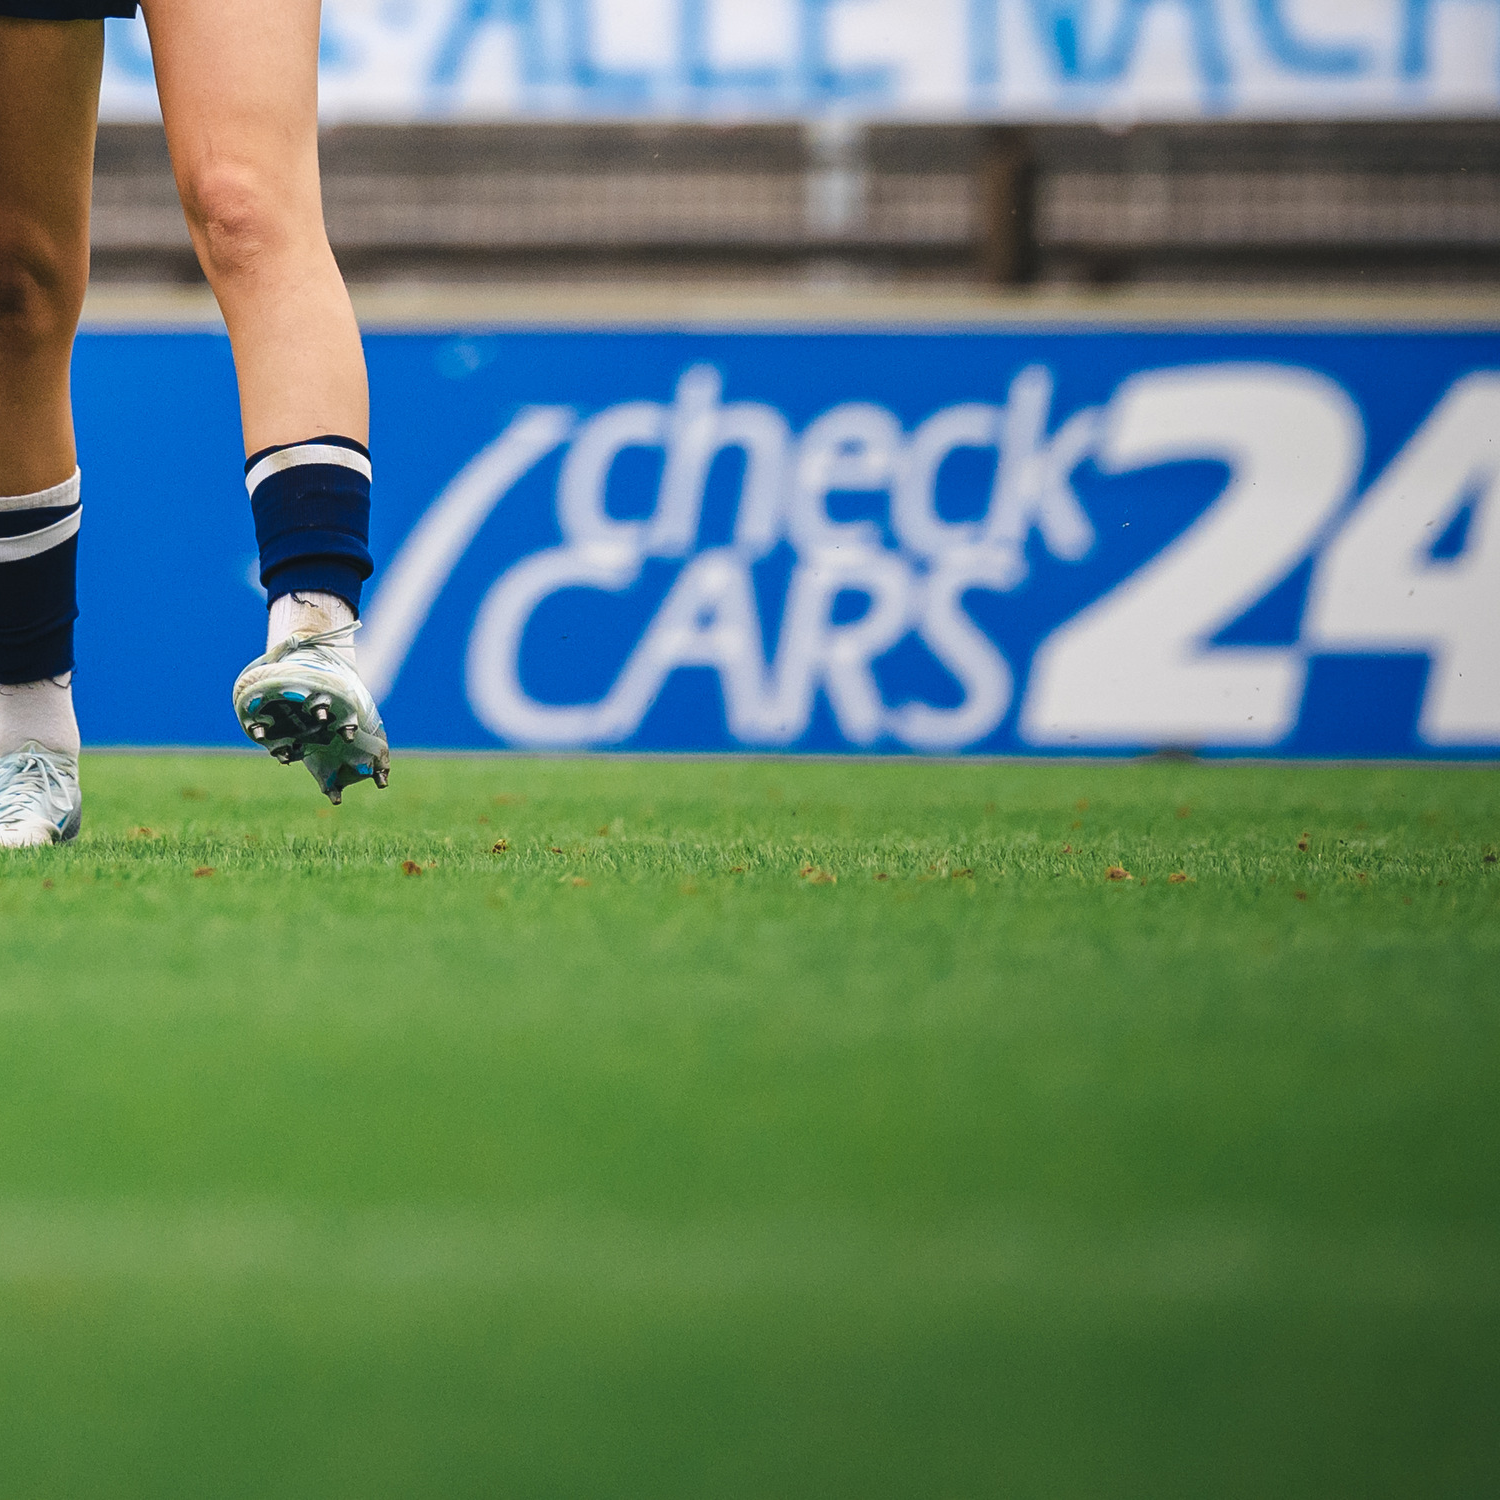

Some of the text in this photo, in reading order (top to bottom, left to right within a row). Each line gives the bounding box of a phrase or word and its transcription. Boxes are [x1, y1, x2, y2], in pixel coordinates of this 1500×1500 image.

[555, 362, 1105, 568] check
[1018, 360, 1500, 748] 24
[462, 538, 1022, 752] CARS
